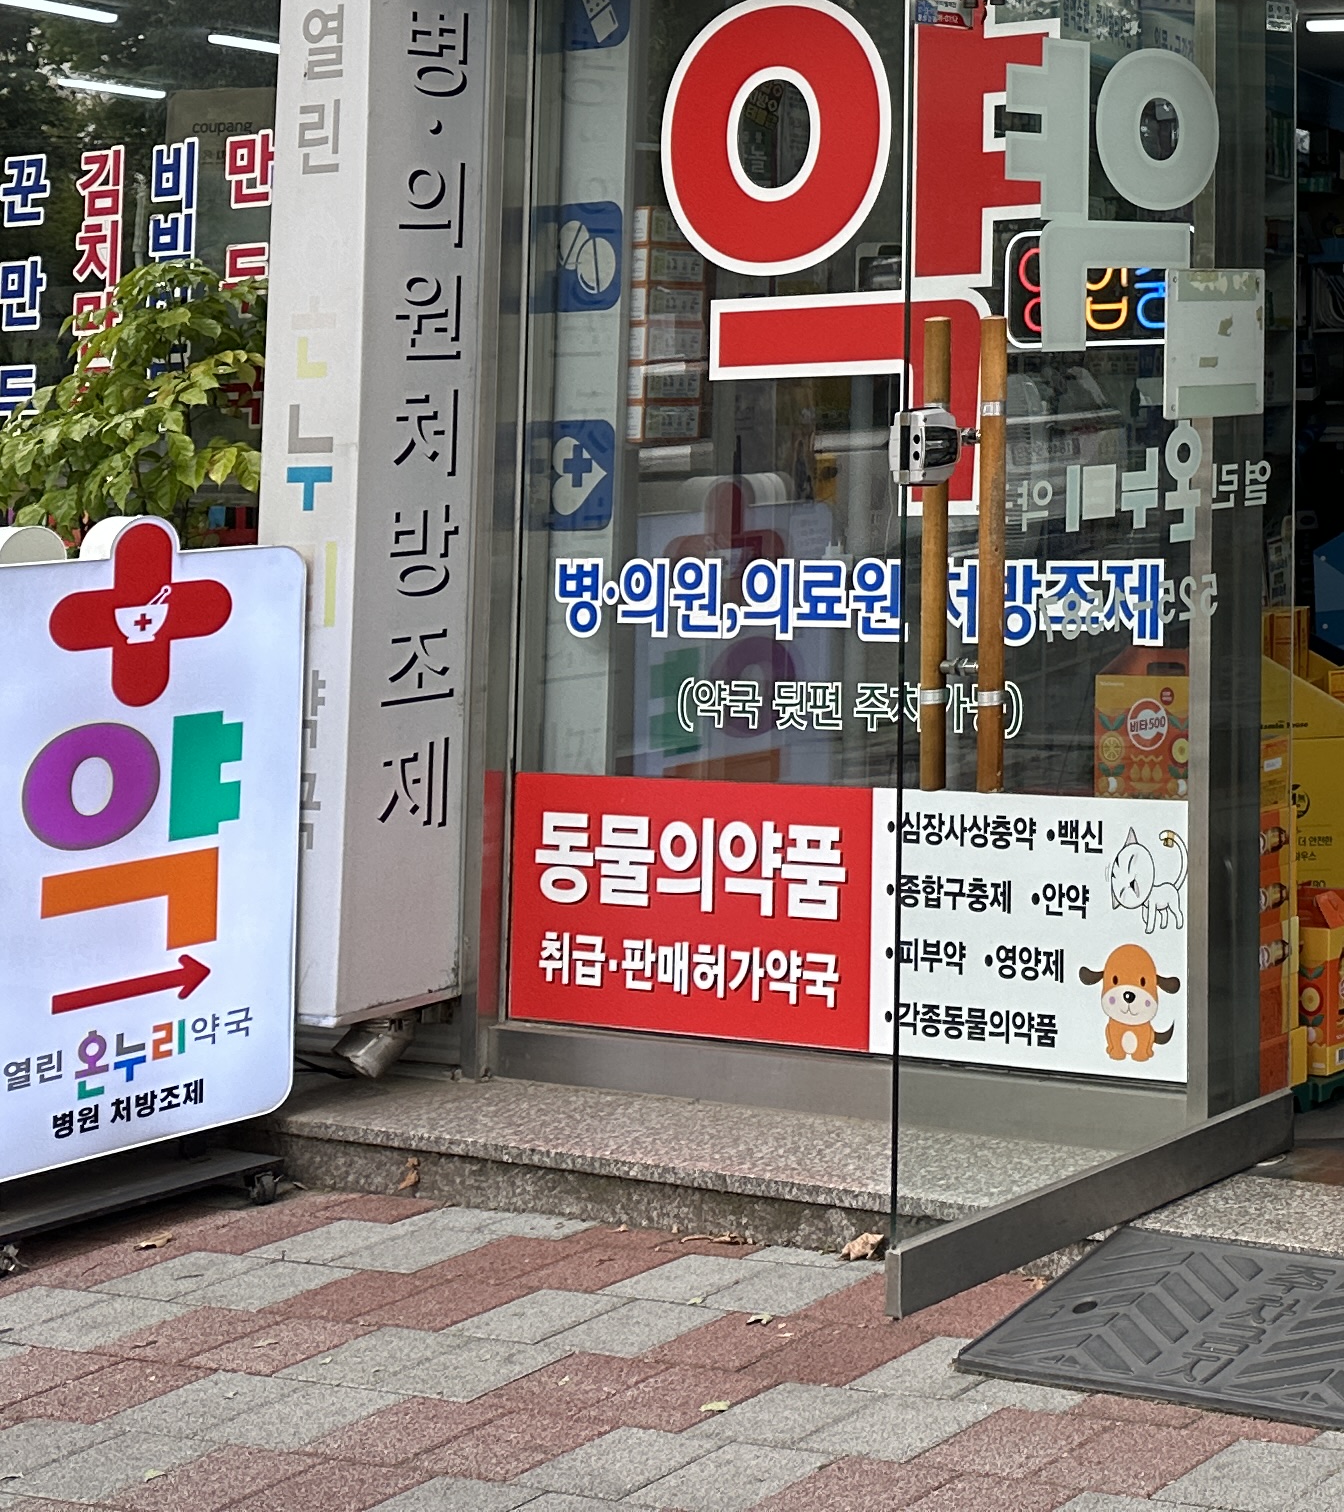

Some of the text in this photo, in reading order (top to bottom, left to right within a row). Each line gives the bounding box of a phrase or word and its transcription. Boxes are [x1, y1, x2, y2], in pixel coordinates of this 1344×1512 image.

[192, 121, 253, 137] coupang
[773, 683, 844, 732] 뒷편
[21, 710, 244, 951] 약
[1056, 819, 1105, 855] 백신
[534, 811, 849, 921] 동물의약품
[1040, 885, 1090, 921] 안약
[994, 946, 1066, 984] 영양제
[3, 1005, 255, 1101] 열린 온누리 약국
[51, 1077, 206, 1139] 병원 처방조제
